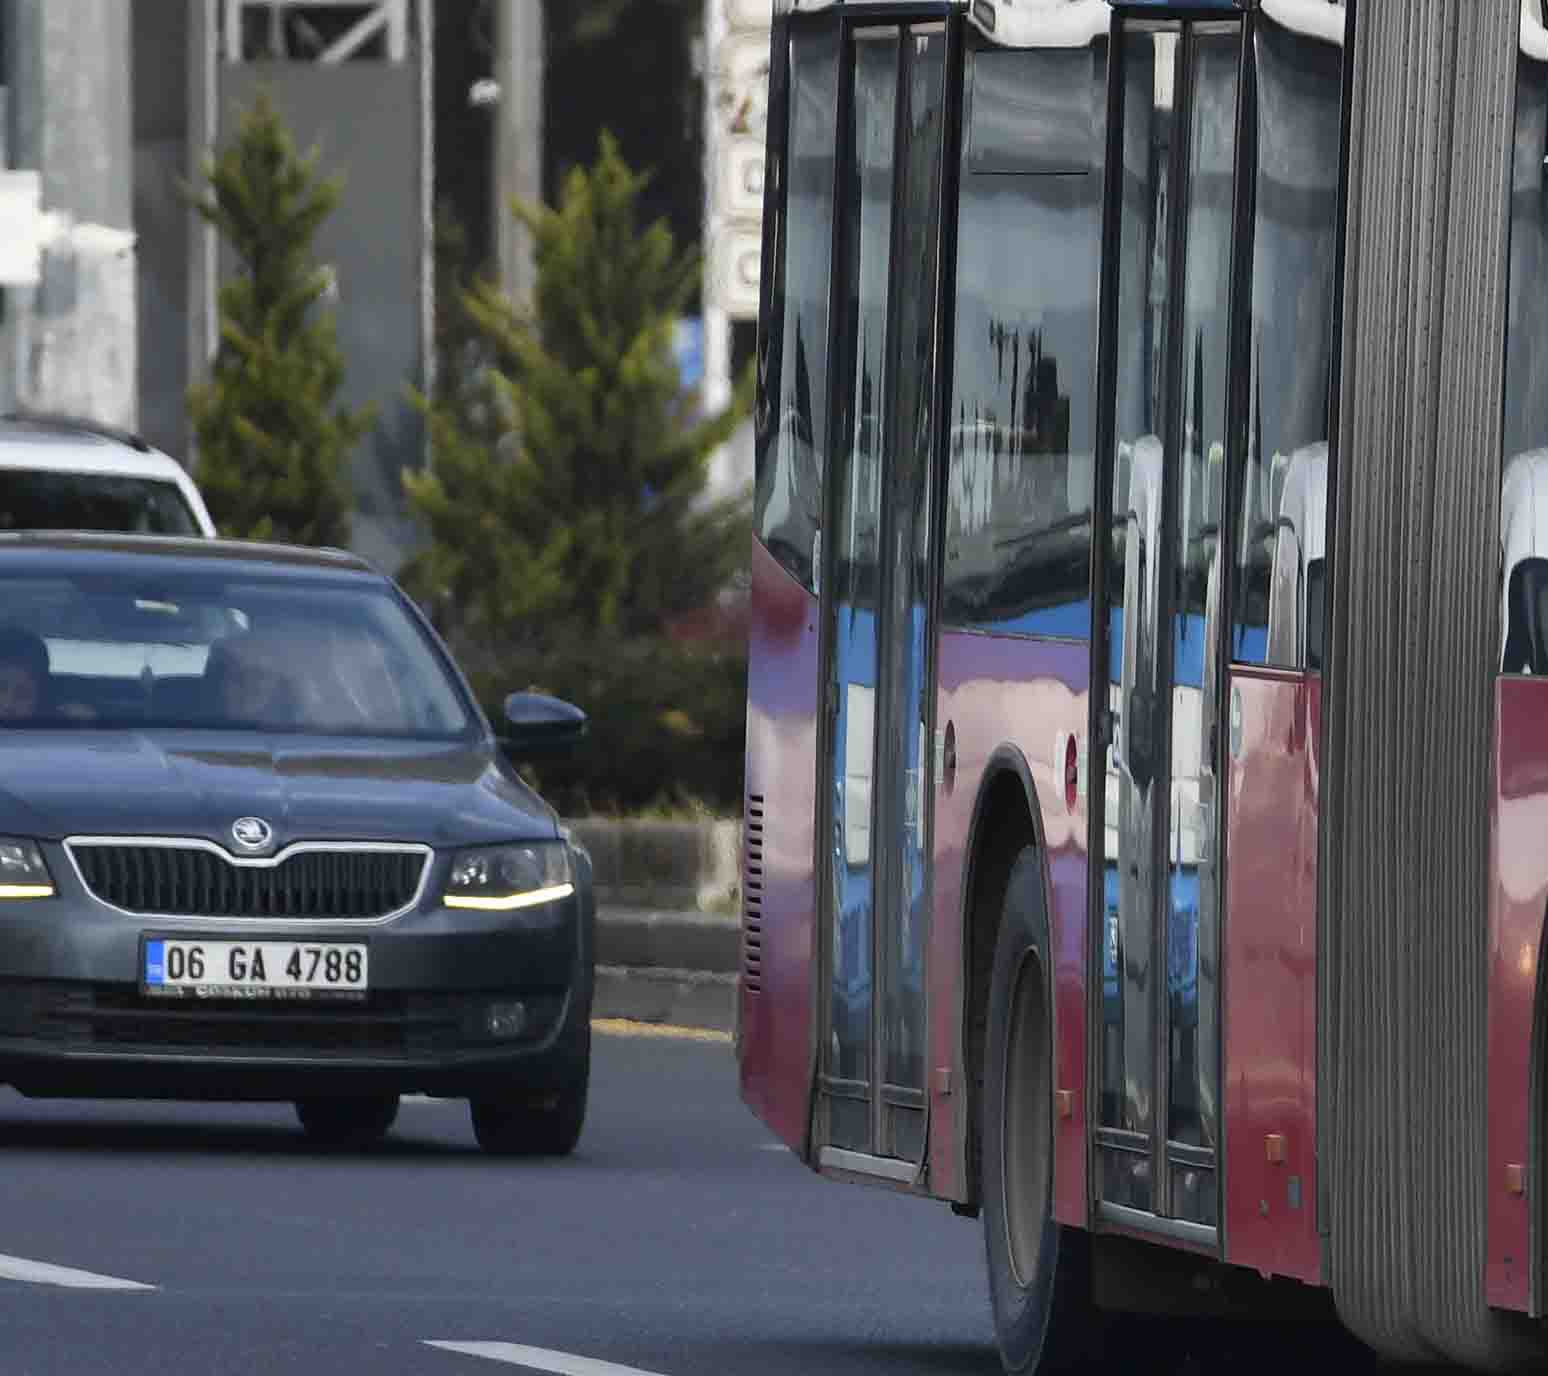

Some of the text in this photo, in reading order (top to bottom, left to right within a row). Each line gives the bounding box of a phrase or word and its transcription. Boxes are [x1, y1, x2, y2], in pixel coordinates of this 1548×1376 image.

[167, 946, 363, 984] 06 GA 4788
